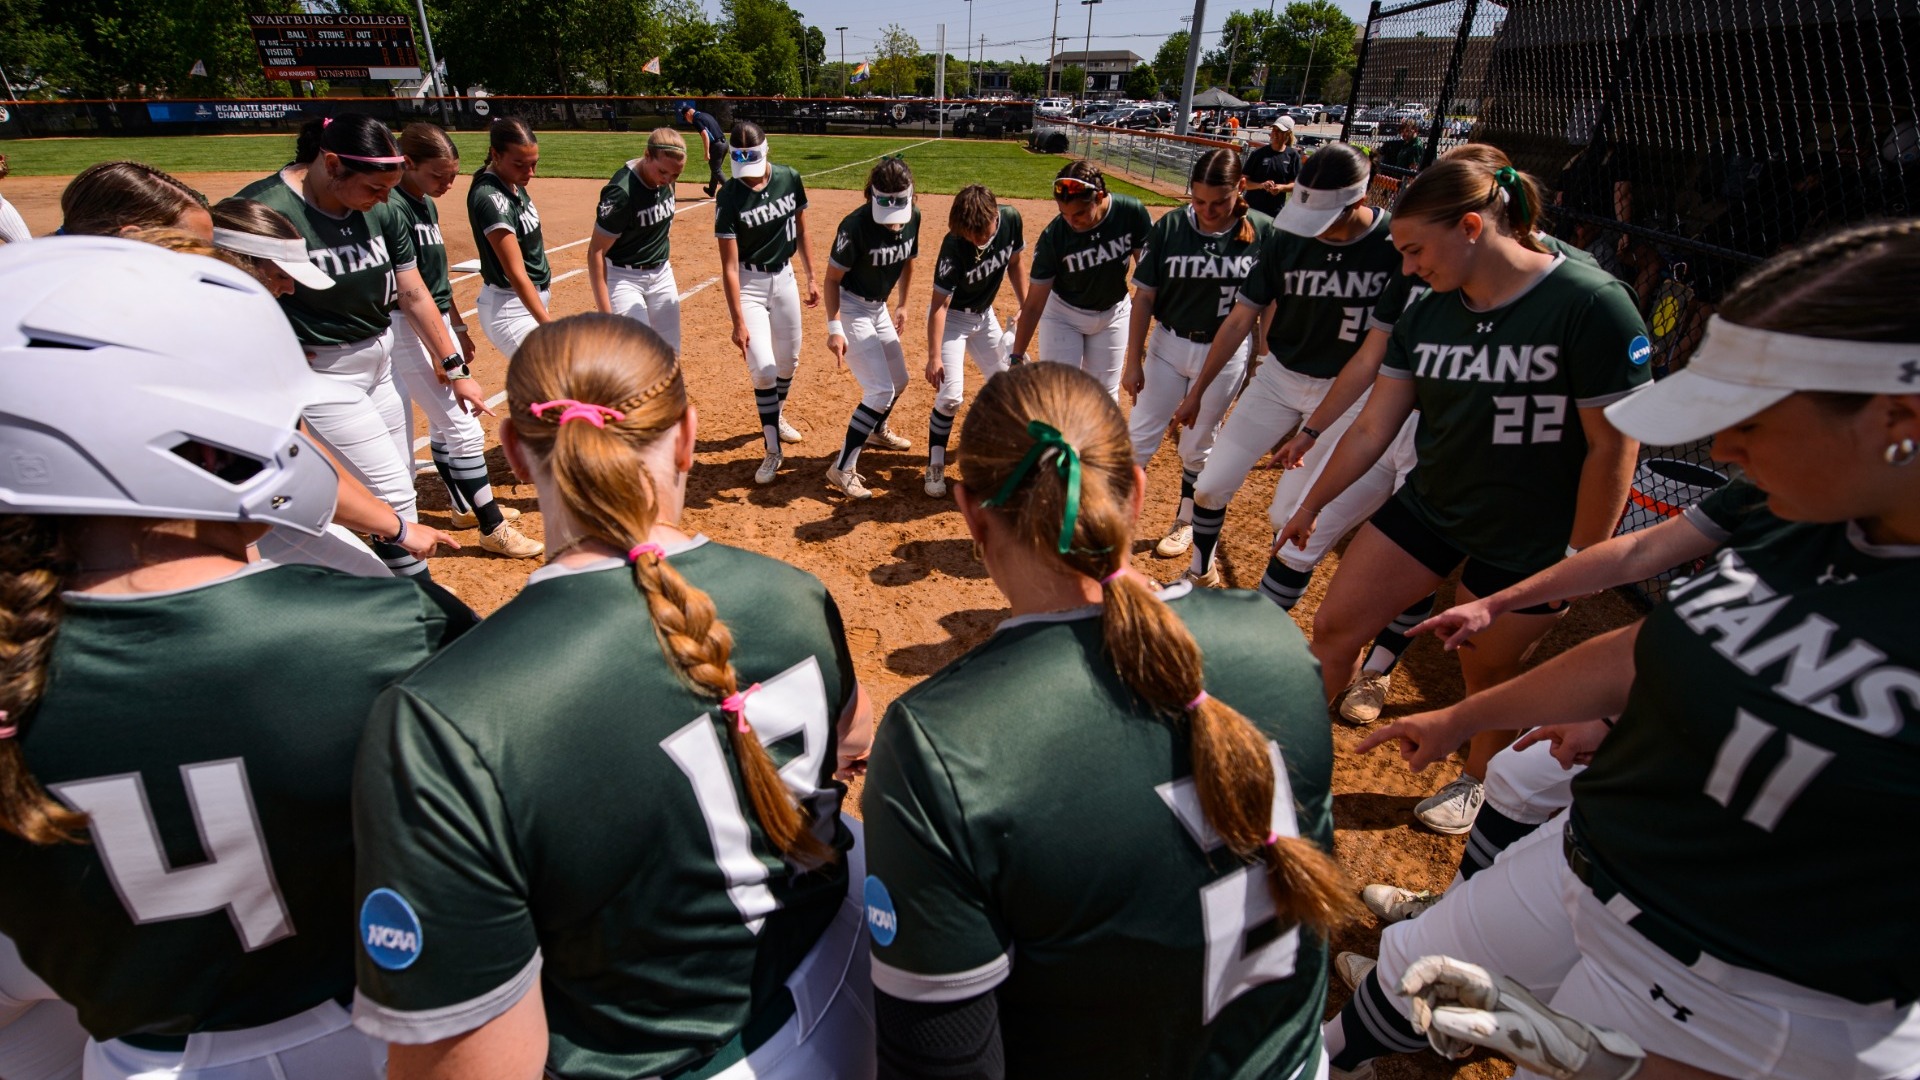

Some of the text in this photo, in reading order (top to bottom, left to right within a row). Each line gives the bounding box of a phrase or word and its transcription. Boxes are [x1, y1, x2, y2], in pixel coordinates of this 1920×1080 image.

[251, 15, 406, 25] WARTBURG COLLEGE
[286, 30, 307, 39] BALL
[318, 30, 345, 39] STRIKE
[356, 30, 371, 39] OUT
[265, 48, 294, 56] VISITOR
[268, 57, 297, 65] KNIGHTS
[344, 69, 368, 78] FIELD
[215, 104, 240, 112] NCAA
[261, 104, 302, 112] SOFTBALL
[217, 111, 286, 119] CHAMPIONSHIP
[740, 192, 797, 229] TITANS
[1062, 232, 1133, 273] TITANS
[1164, 255, 1252, 278] TITANS
[1284, 269, 1388, 298] TITANS
[1413, 342, 1560, 383] TITANS
[1492, 395, 1568, 445] 22
[1703, 705, 1838, 834] 11
[47, 756, 298, 953] 4
[867, 904, 894, 933] NCAA
[367, 923, 417, 954] NCAA
